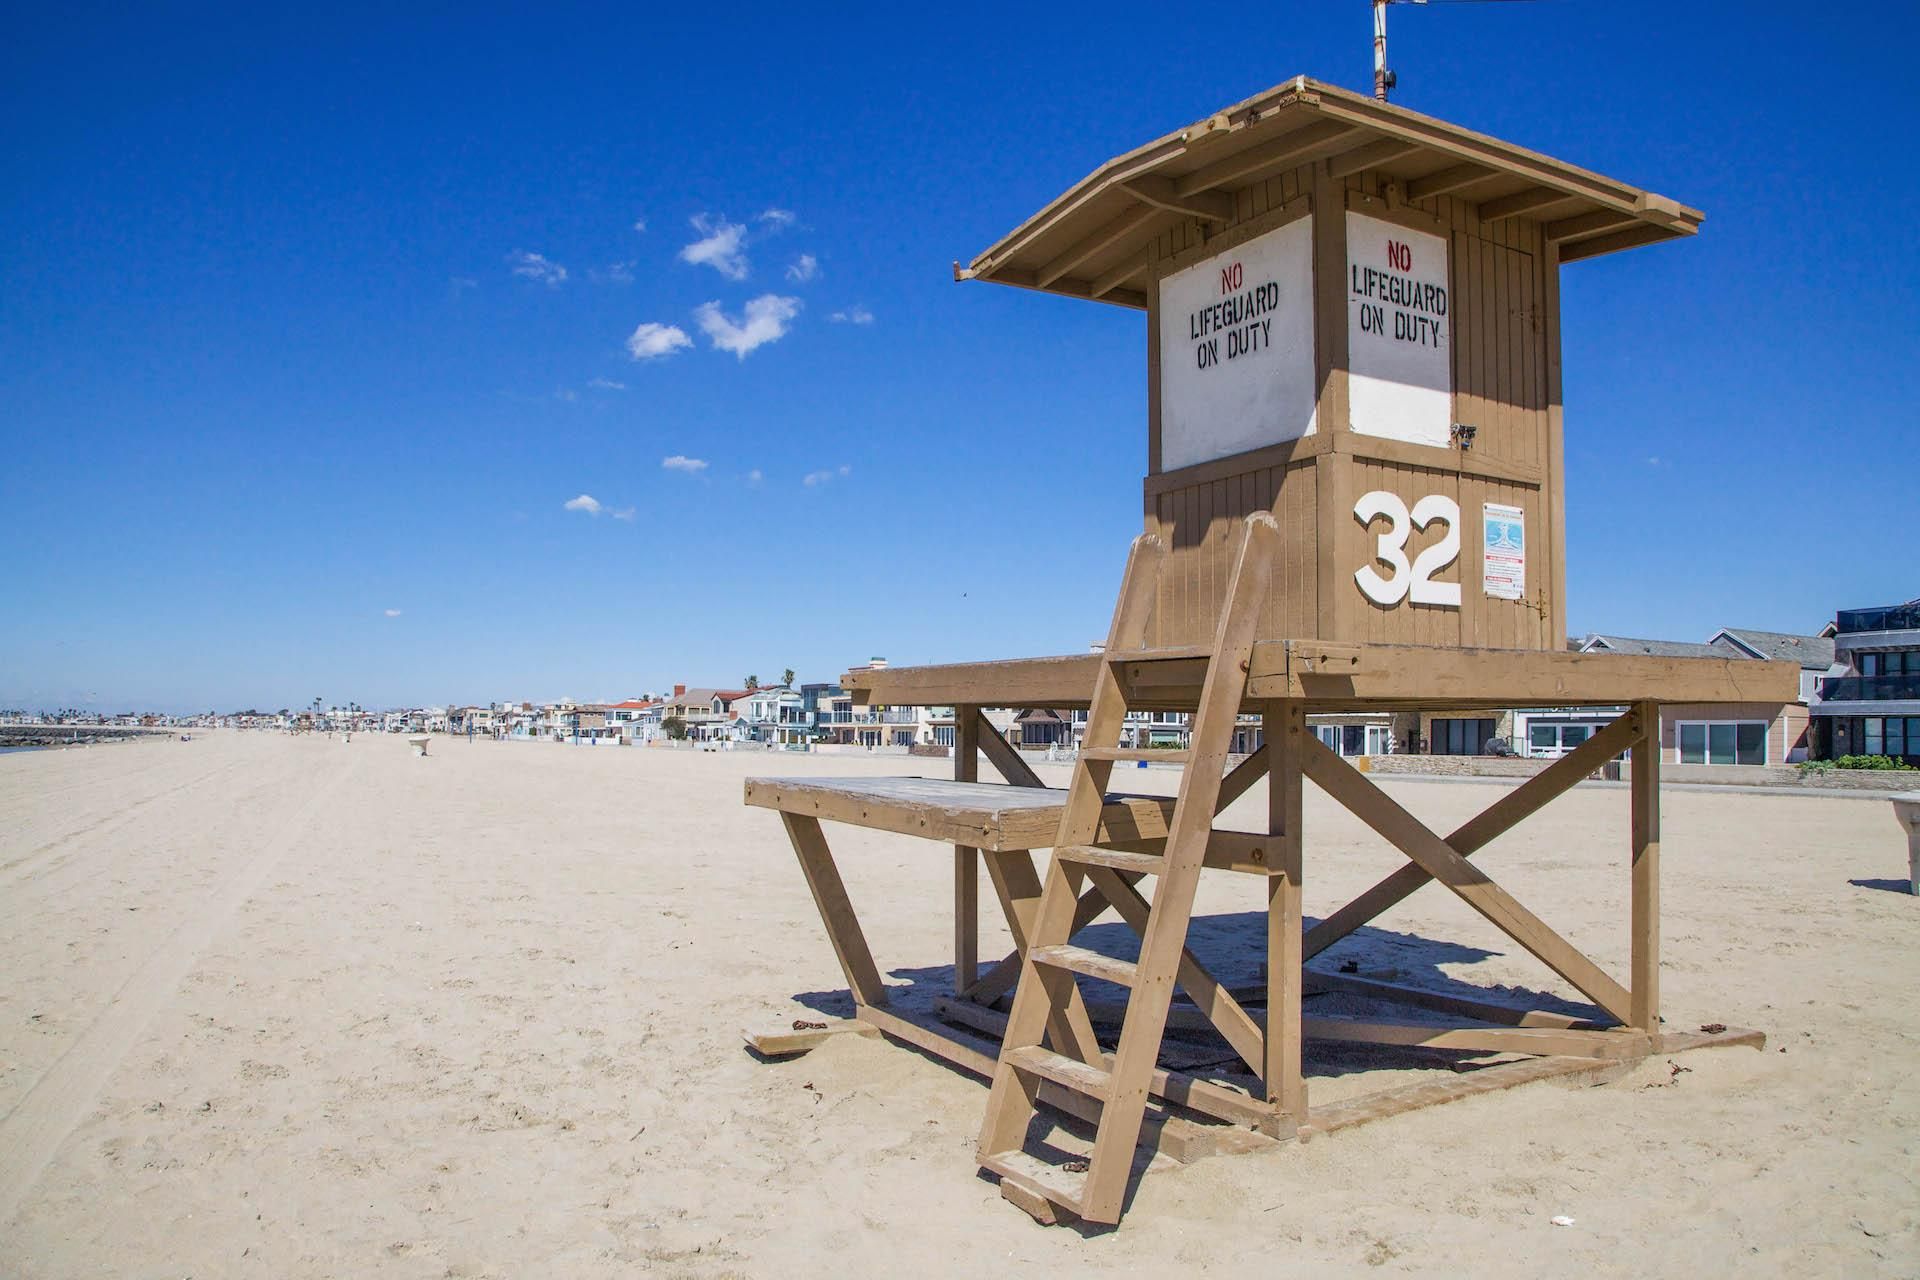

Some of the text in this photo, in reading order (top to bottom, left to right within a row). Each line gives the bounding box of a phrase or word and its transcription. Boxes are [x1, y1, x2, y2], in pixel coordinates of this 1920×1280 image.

[1221, 262, 1243, 295] NO
[1387, 239, 1411, 272] NO
[1191, 281, 1279, 340] LIFEGUARD
[1352, 264, 1446, 316] LIFEGUARD
[1198, 318, 1271, 369] ON DUTY
[1361, 303, 1440, 348] ON DUTY
[1353, 490, 1462, 605] 32
